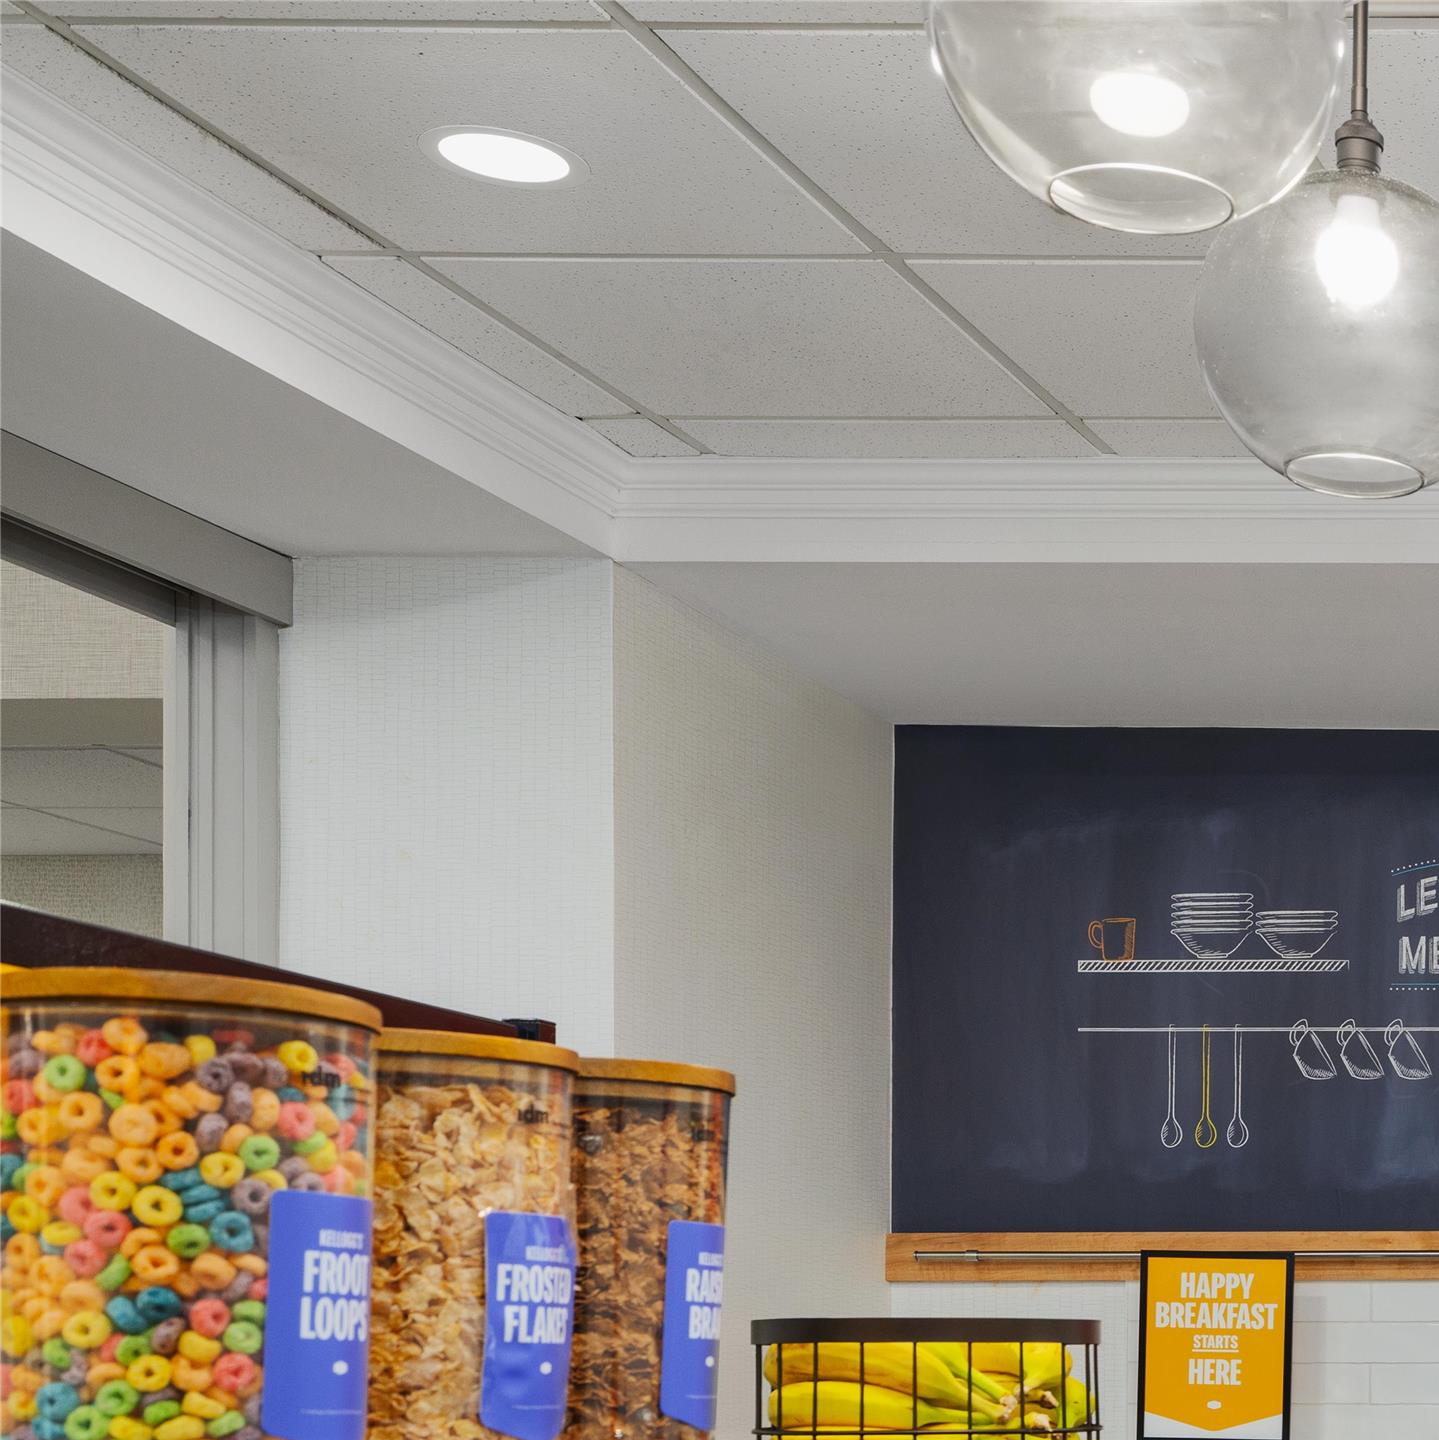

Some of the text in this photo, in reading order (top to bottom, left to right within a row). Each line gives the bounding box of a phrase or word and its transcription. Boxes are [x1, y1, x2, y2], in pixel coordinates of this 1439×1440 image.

[303, 1250, 370, 1297] FROOT
[1180, 1272, 1254, 1299] HAPPY
[300, 1297, 368, 1342] LOOPS
[689, 1305, 720, 1340] BRA
[1155, 1302, 1278, 1329] BREAKFAST
[1193, 1335, 1239, 1349] STARTS
[1188, 1359, 1242, 1386] HERE
